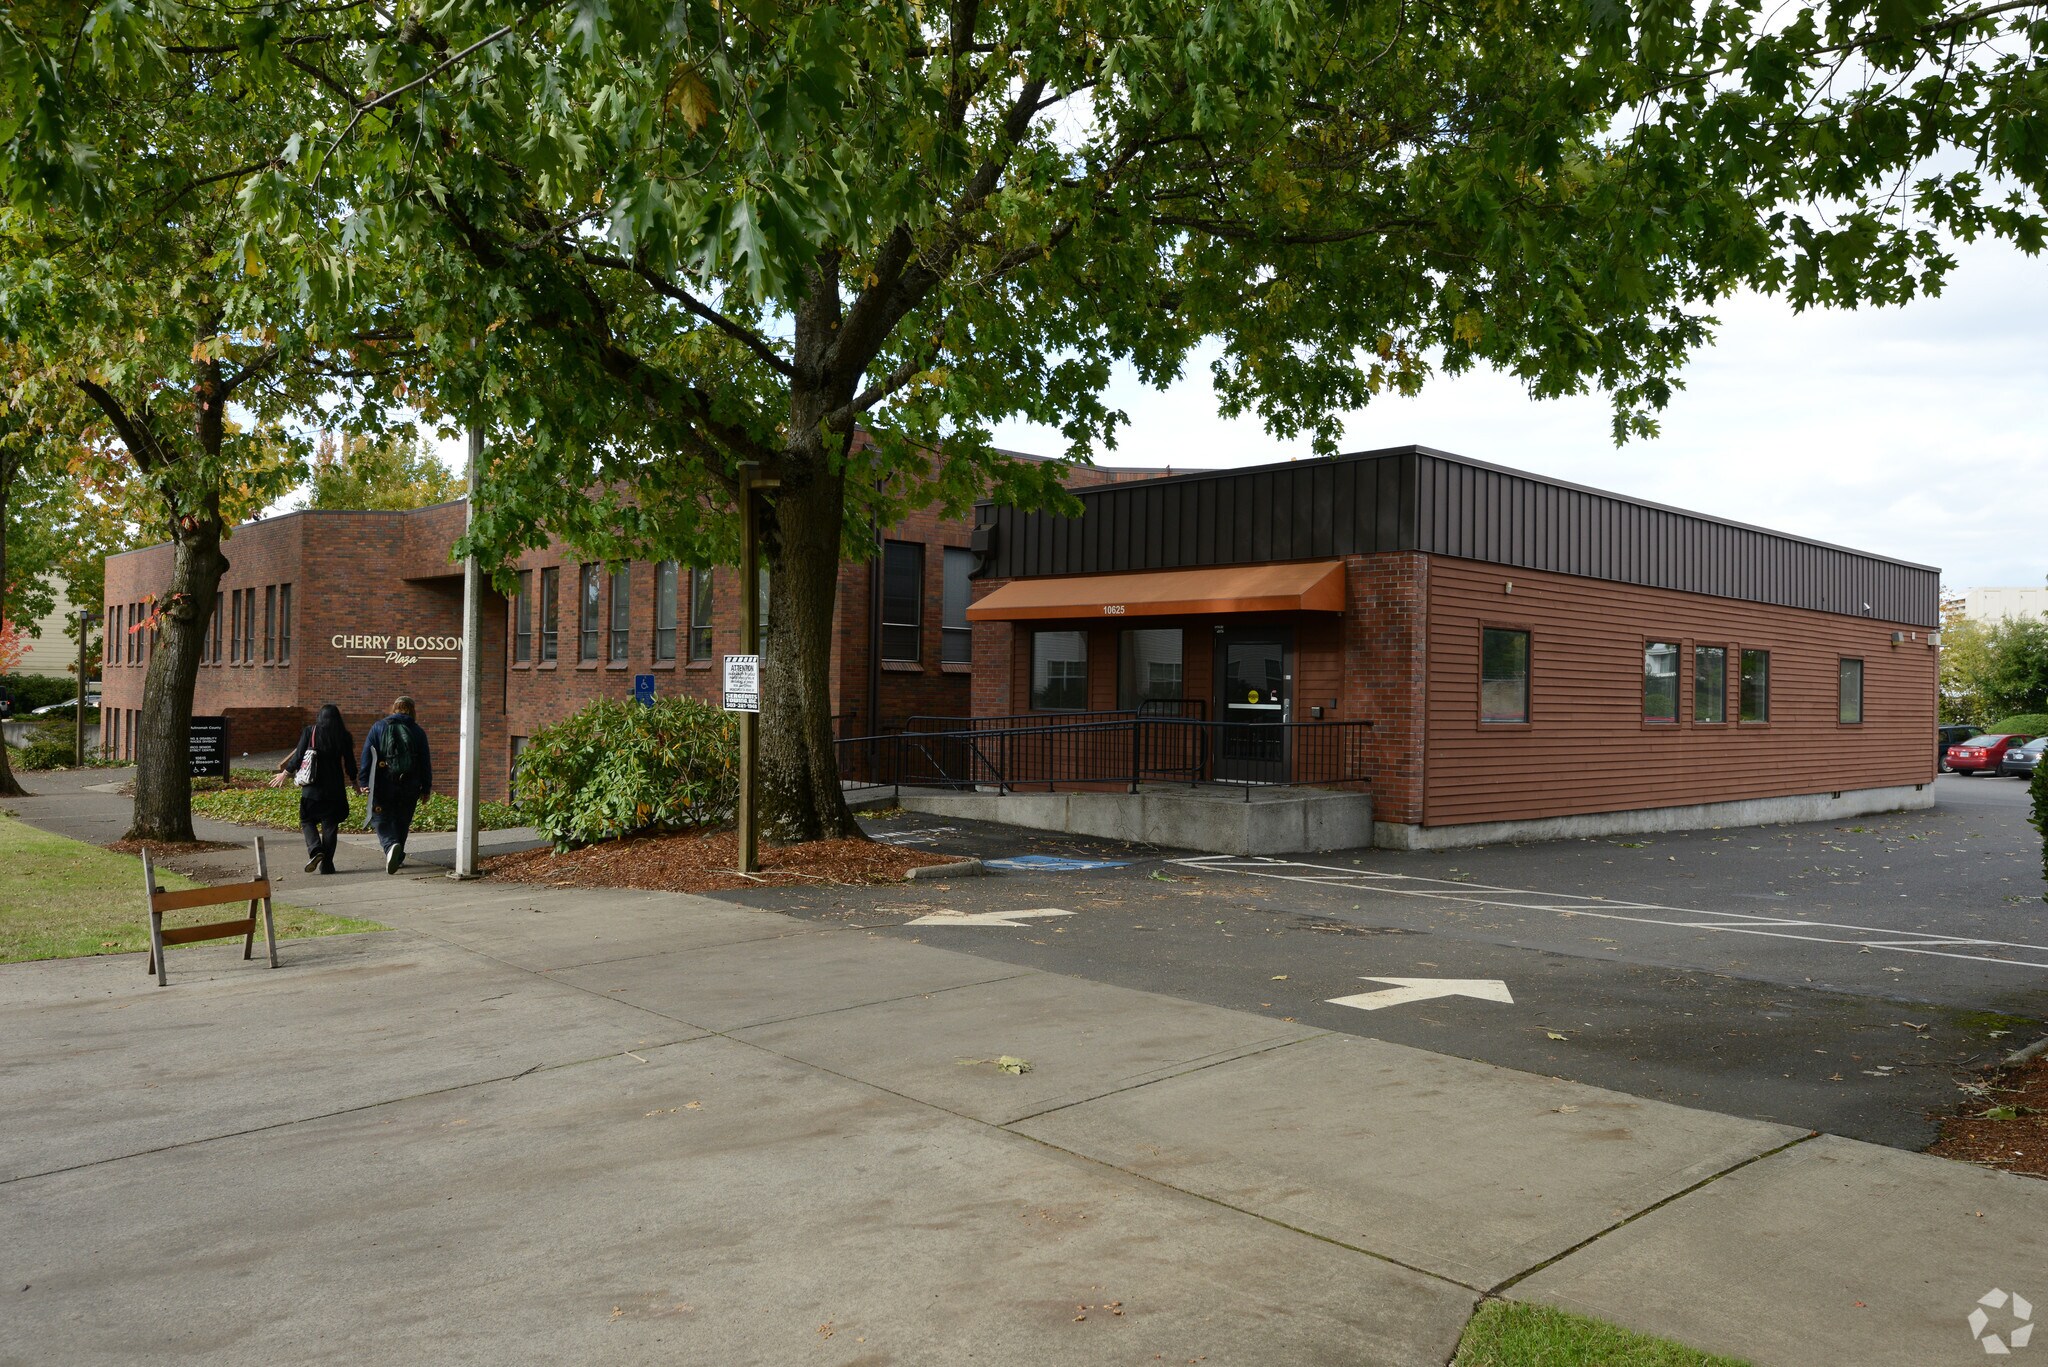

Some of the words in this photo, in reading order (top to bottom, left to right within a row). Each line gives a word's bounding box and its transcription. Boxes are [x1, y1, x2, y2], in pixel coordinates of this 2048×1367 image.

[1103, 605, 1125, 615] 10625
[331, 634, 391, 649] CHERRY
[385, 651, 418, 667] Plaza
